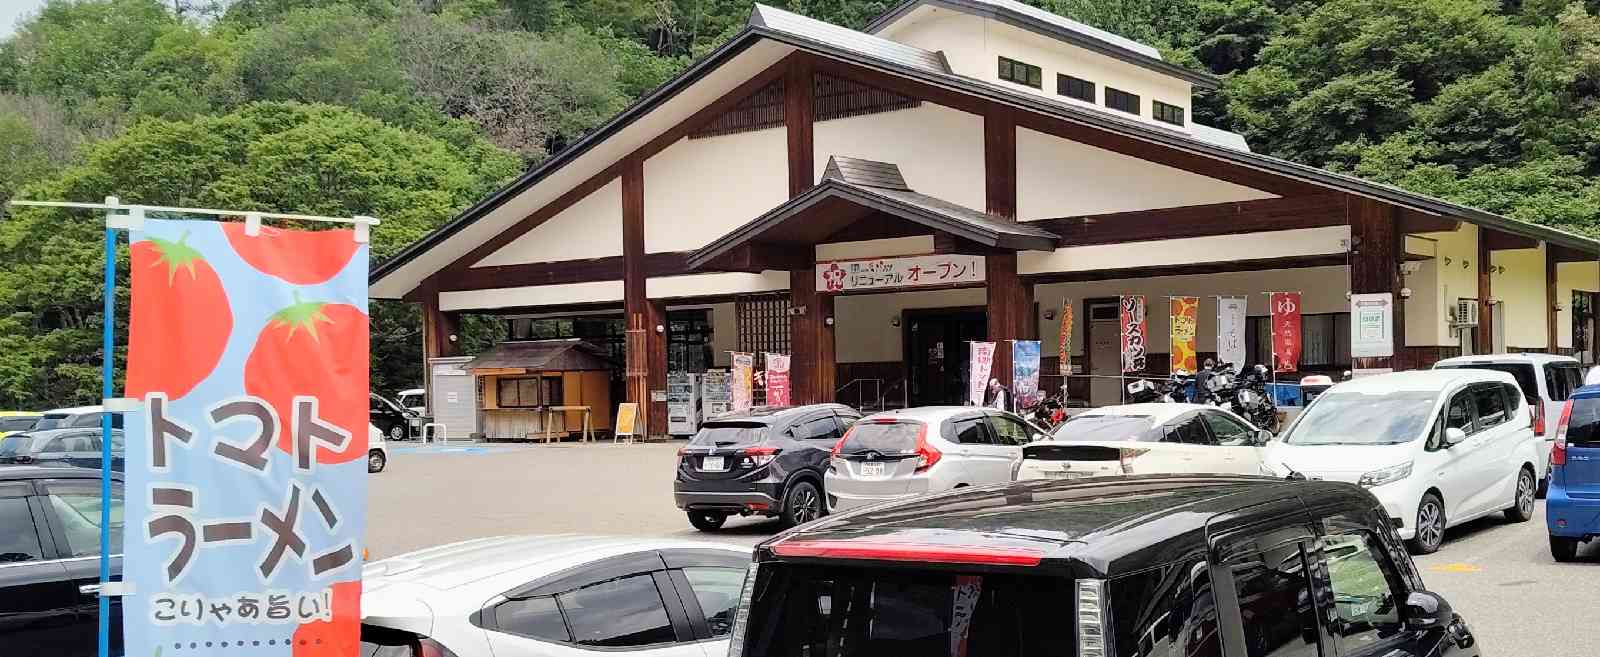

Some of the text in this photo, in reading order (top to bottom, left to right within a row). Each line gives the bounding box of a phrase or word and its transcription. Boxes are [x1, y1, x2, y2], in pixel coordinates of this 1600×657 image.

[1277, 298, 1296, 315] ゆ
[149, 396, 347, 472] トマト
[148, 483, 354, 582] ラーメン
